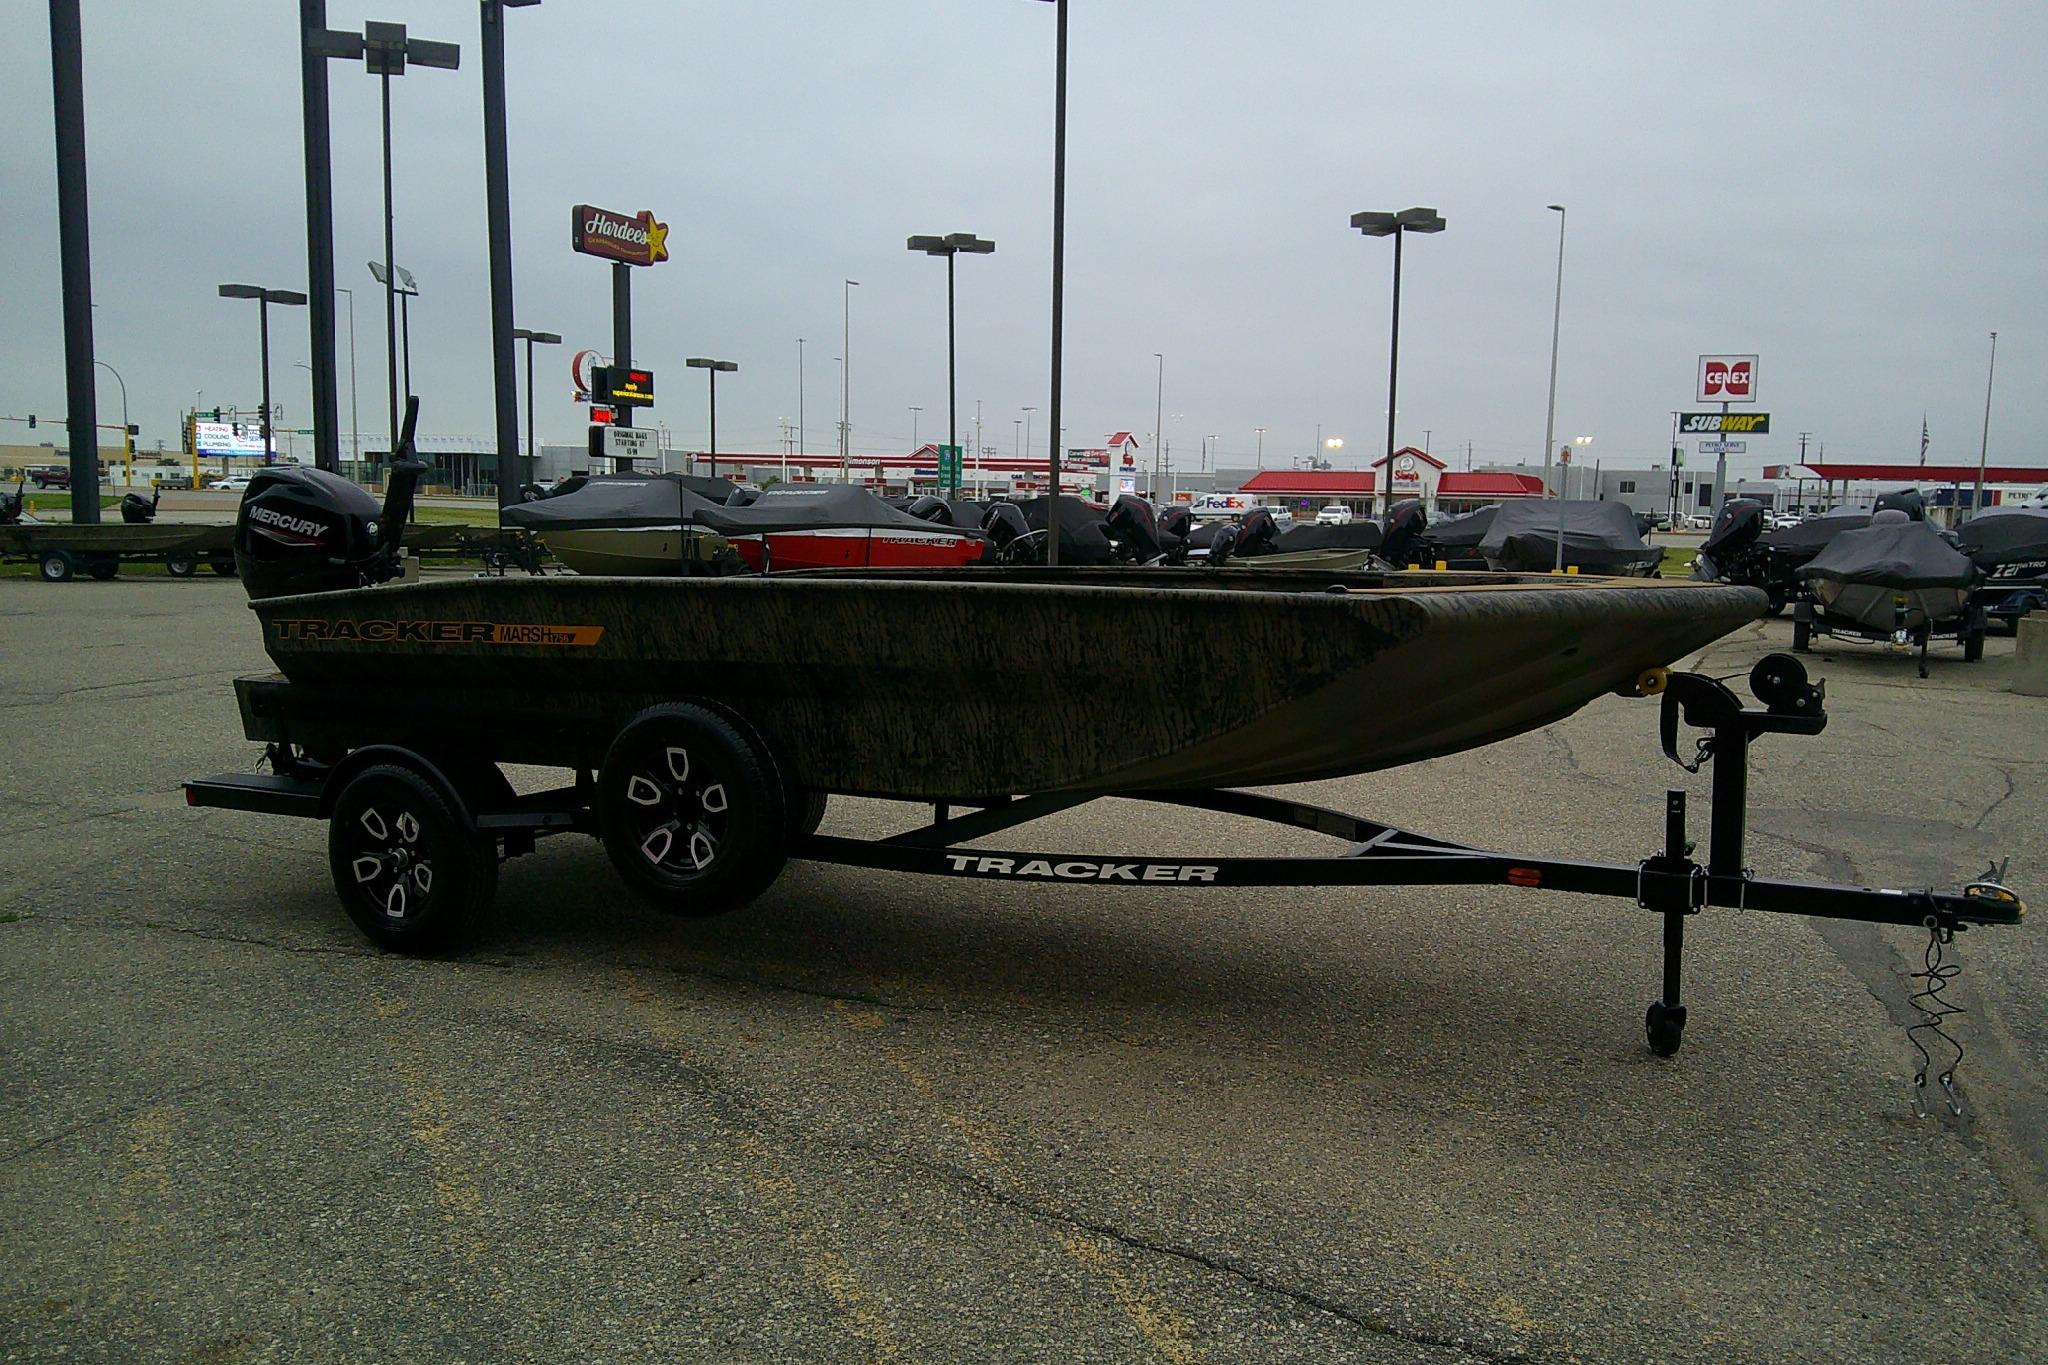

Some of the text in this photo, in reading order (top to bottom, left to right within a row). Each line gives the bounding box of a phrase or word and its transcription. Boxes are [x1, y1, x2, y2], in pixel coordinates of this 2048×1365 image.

[585, 213, 647, 245] Hardee's
[1706, 372, 1749, 384] CENEX
[1684, 415, 1766, 431] SUBWAY
[847, 456, 881, 465] imonson
[1206, 496, 1244, 509] FedEx
[249, 506, 329, 537] MERCURY
[272, 619, 495, 643] TRACKER
[500, 626, 551, 642] MARSH
[1832, 628, 1862, 637] TRACKER
[946, 854, 1219, 881] TRACKER
